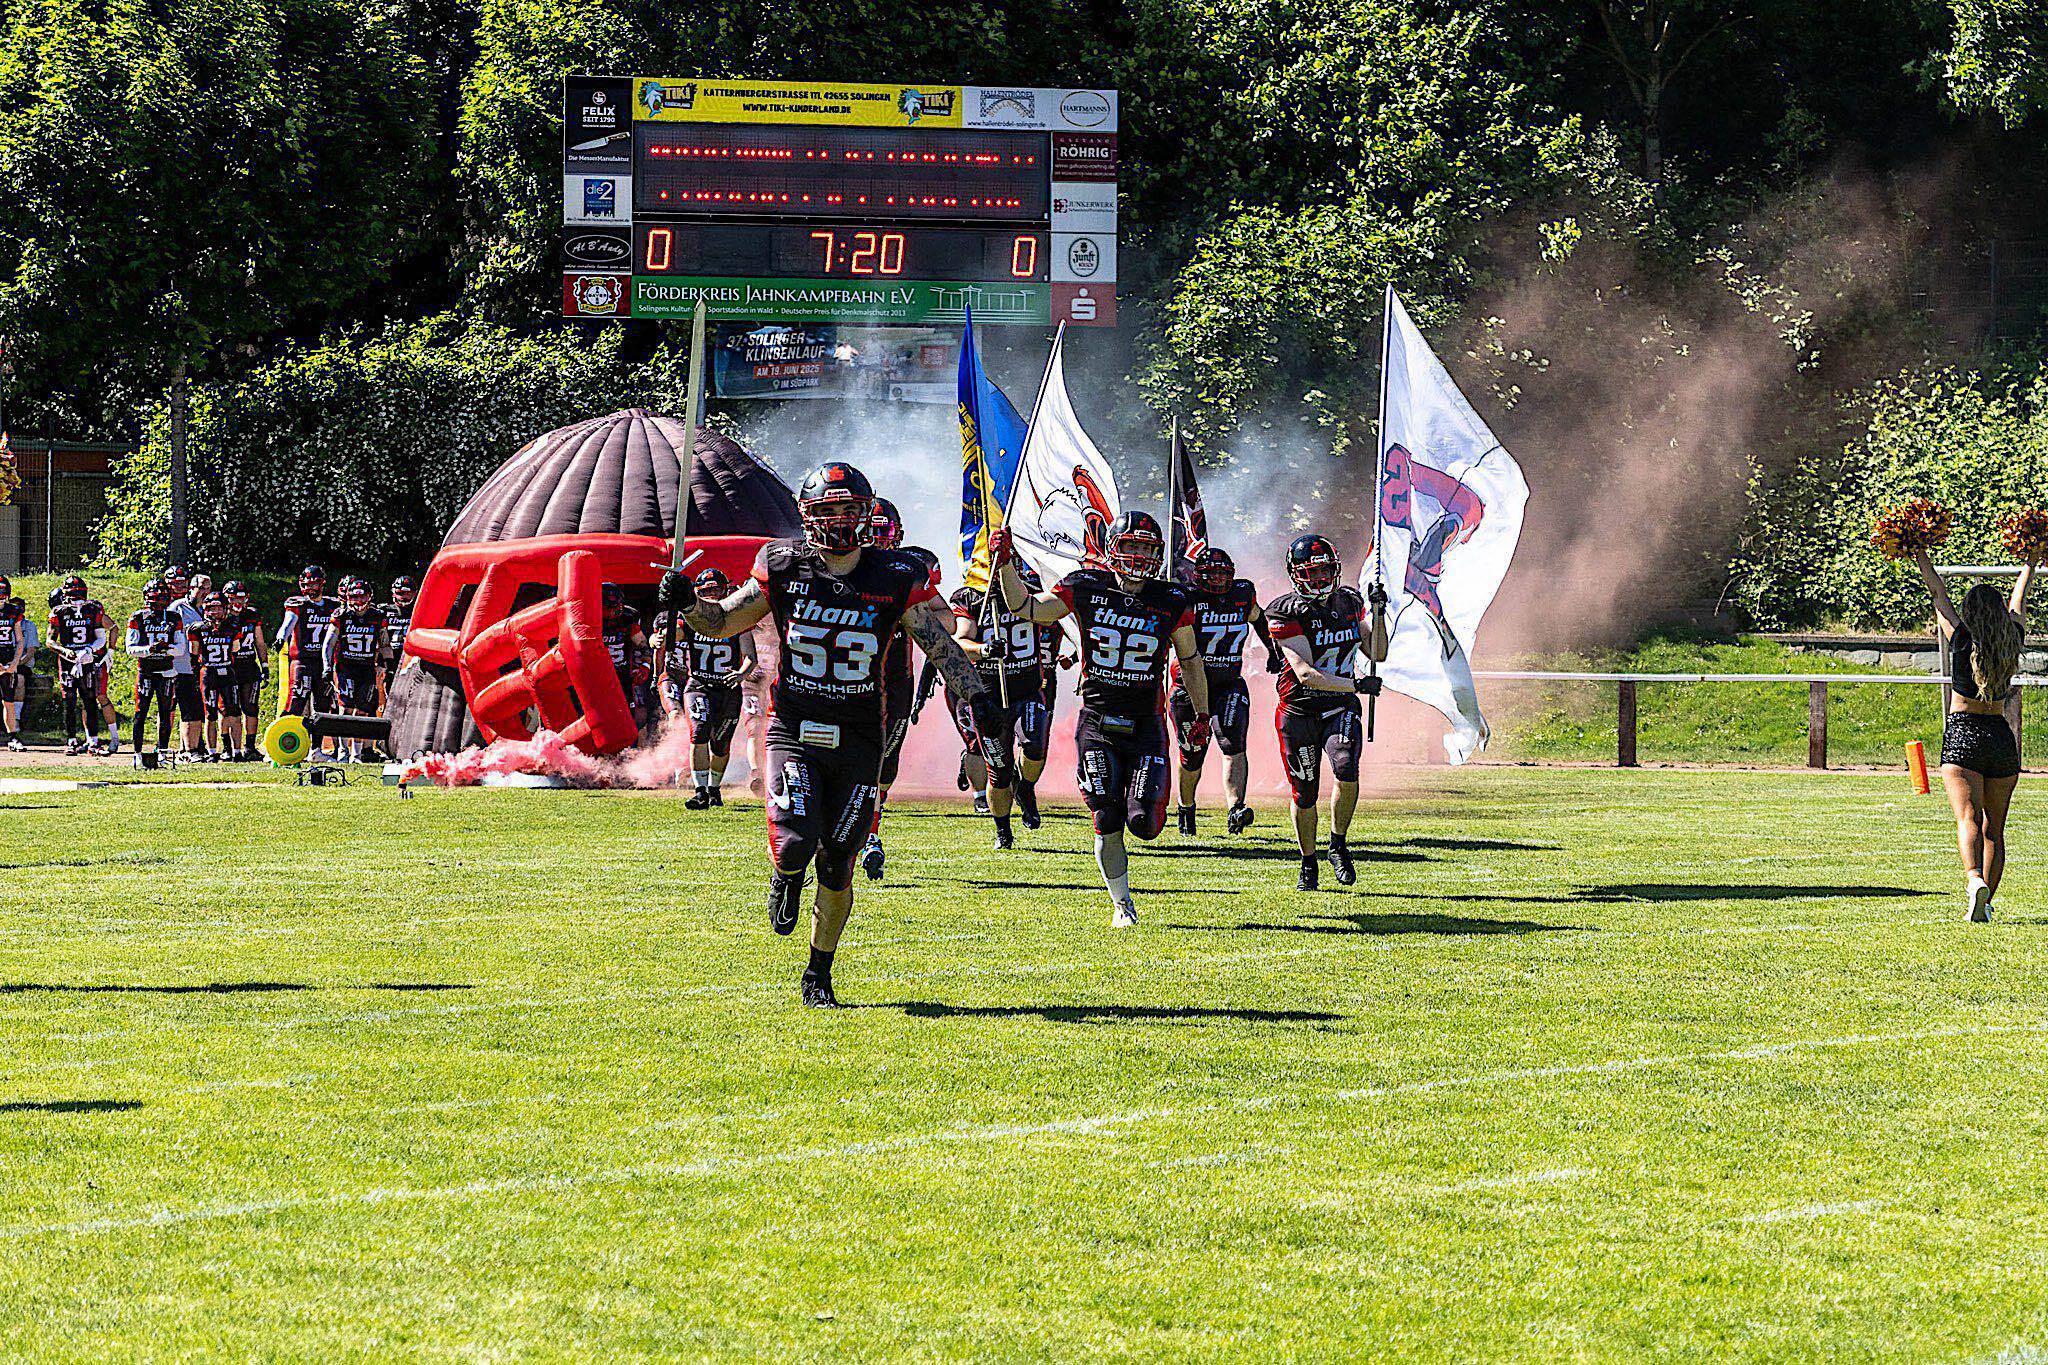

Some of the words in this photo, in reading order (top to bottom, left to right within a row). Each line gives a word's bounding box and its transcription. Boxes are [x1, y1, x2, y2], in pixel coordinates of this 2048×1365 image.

[665, 87, 691, 100] TIKI
[823, 91, 849, 101] 42655
[850, 91, 891, 103] SOLINGEN
[924, 94, 950, 107] TIKI
[582, 106, 616, 116] FELIX
[1063, 105, 1108, 113] HARTMANNS
[1060, 144, 1109, 158] RÖHRIG
[647, 228, 672, 270] 0
[810, 231, 904, 275] 7:20
[1011, 235, 1037, 277] 0
[638, 282, 740, 302] FÖRDERKREIS
[745, 284, 885, 304] JAHNKAMPFBAHN
[638, 305, 669, 314] Solingens
[670, 305, 693, 313] Kultur-
[707, 306, 749, 316] Sportstadion
[749, 307, 757, 315] in
[757, 307, 773, 315] Wald
[781, 307, 813, 316] Deutscher
[814, 308, 830, 316] Preis
[831, 308, 840, 317] für
[841, 309, 889, 318] Denkmalschutz
[890, 309, 906, 319] 2013
[747, 332, 806, 346] SOLINGER
[745, 345, 826, 362] KLINGENLAUF
[756, 368, 769, 377] AM
[782, 365, 800, 375] JUNI
[800, 364, 820, 374] 2025
[780, 380, 790, 389] IM
[786, 580, 809, 596] IFU
[1090, 594, 1108, 606] IFU
[72, 627, 87, 644] 3
[347, 633, 374, 653] 51
[1201, 623, 1248, 655] 77
[206, 643, 230, 663] 21
[786, 621, 879, 683] 53
[1090, 626, 1159, 671] 32
[693, 643, 733, 674] 72
[1313, 642, 1362, 679] 44
[1088, 665, 1155, 682] JUCHHEIM
[786, 674, 876, 696] JUCHHEIM
